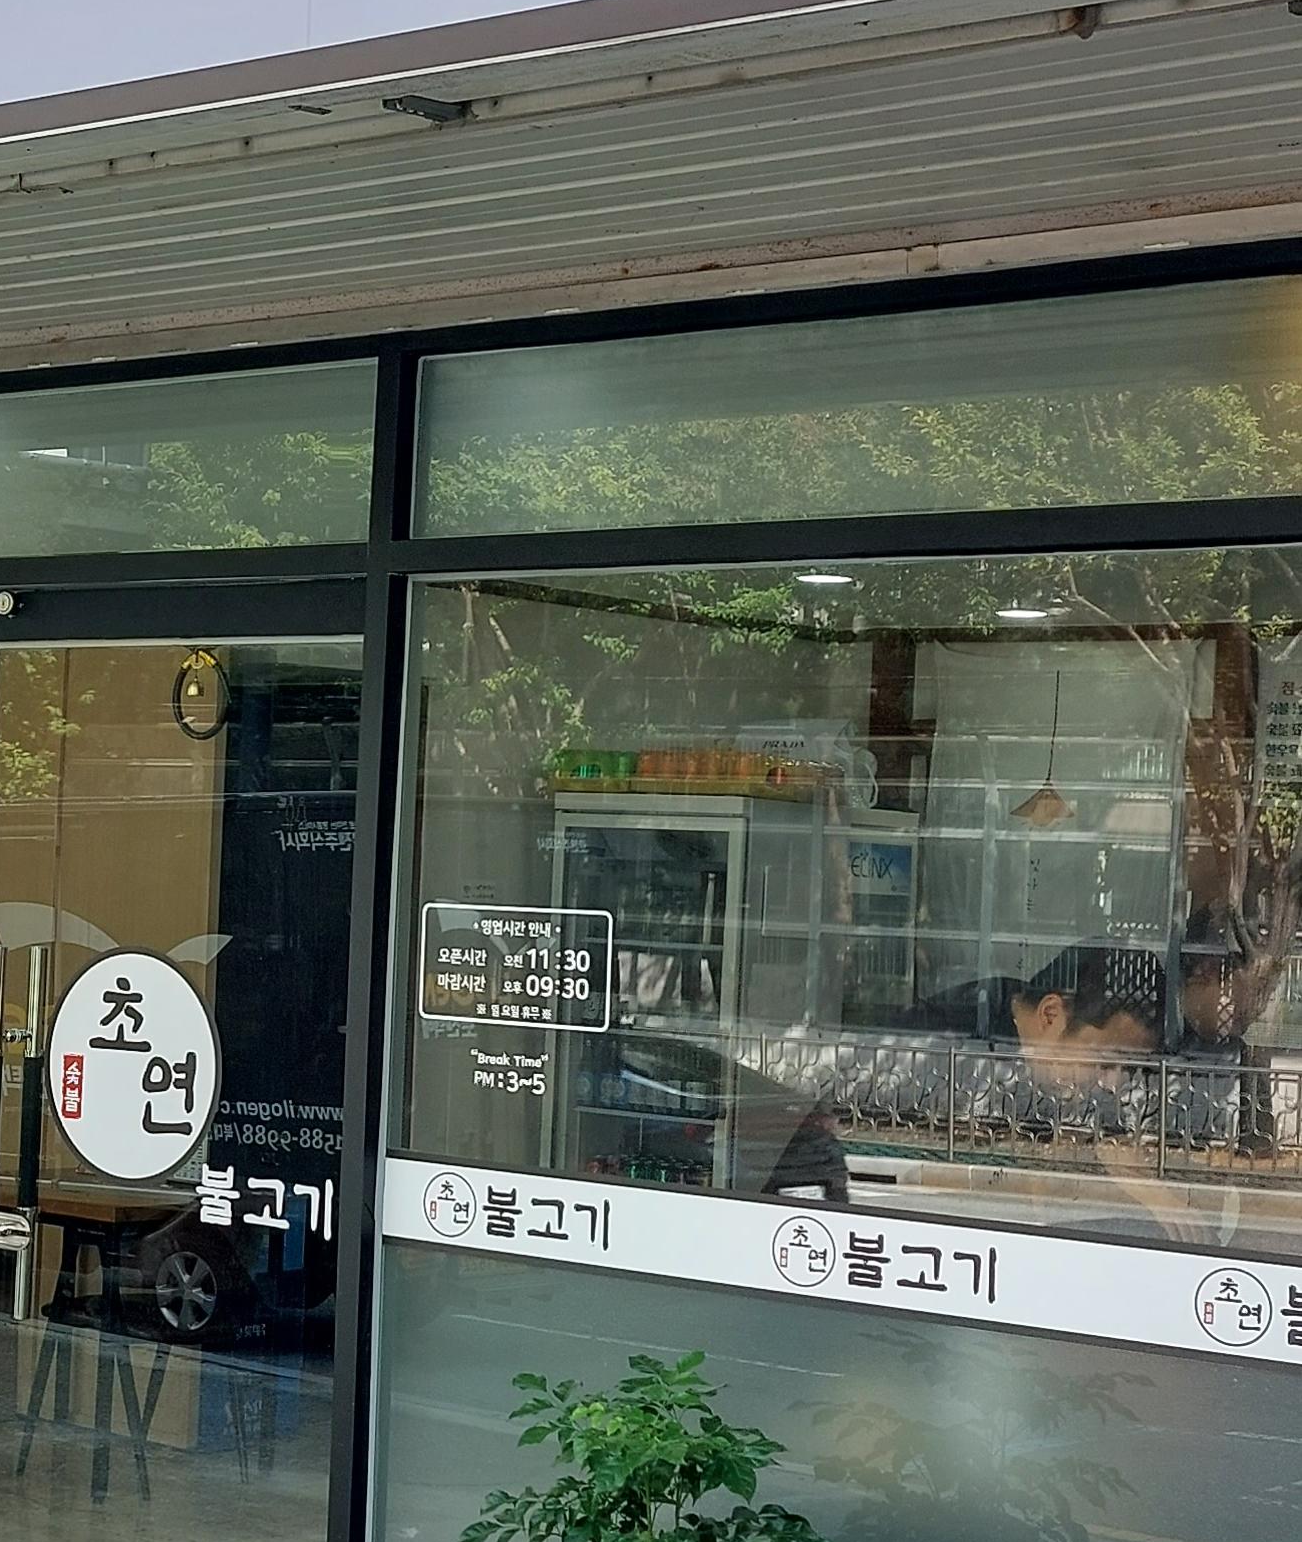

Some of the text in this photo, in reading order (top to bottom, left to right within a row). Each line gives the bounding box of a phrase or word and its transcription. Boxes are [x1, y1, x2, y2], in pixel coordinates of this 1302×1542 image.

[481, 920, 552, 939] 영업시간 안내
[437, 947, 591, 973] 오픈시간 오전 11:30
[437, 972, 590, 1000] 마감시간 오후 09:30
[196, 1163, 334, 1242] 불고기
[482, 1185, 611, 1251] 불고기
[842, 1231, 997, 1304] 불고기
